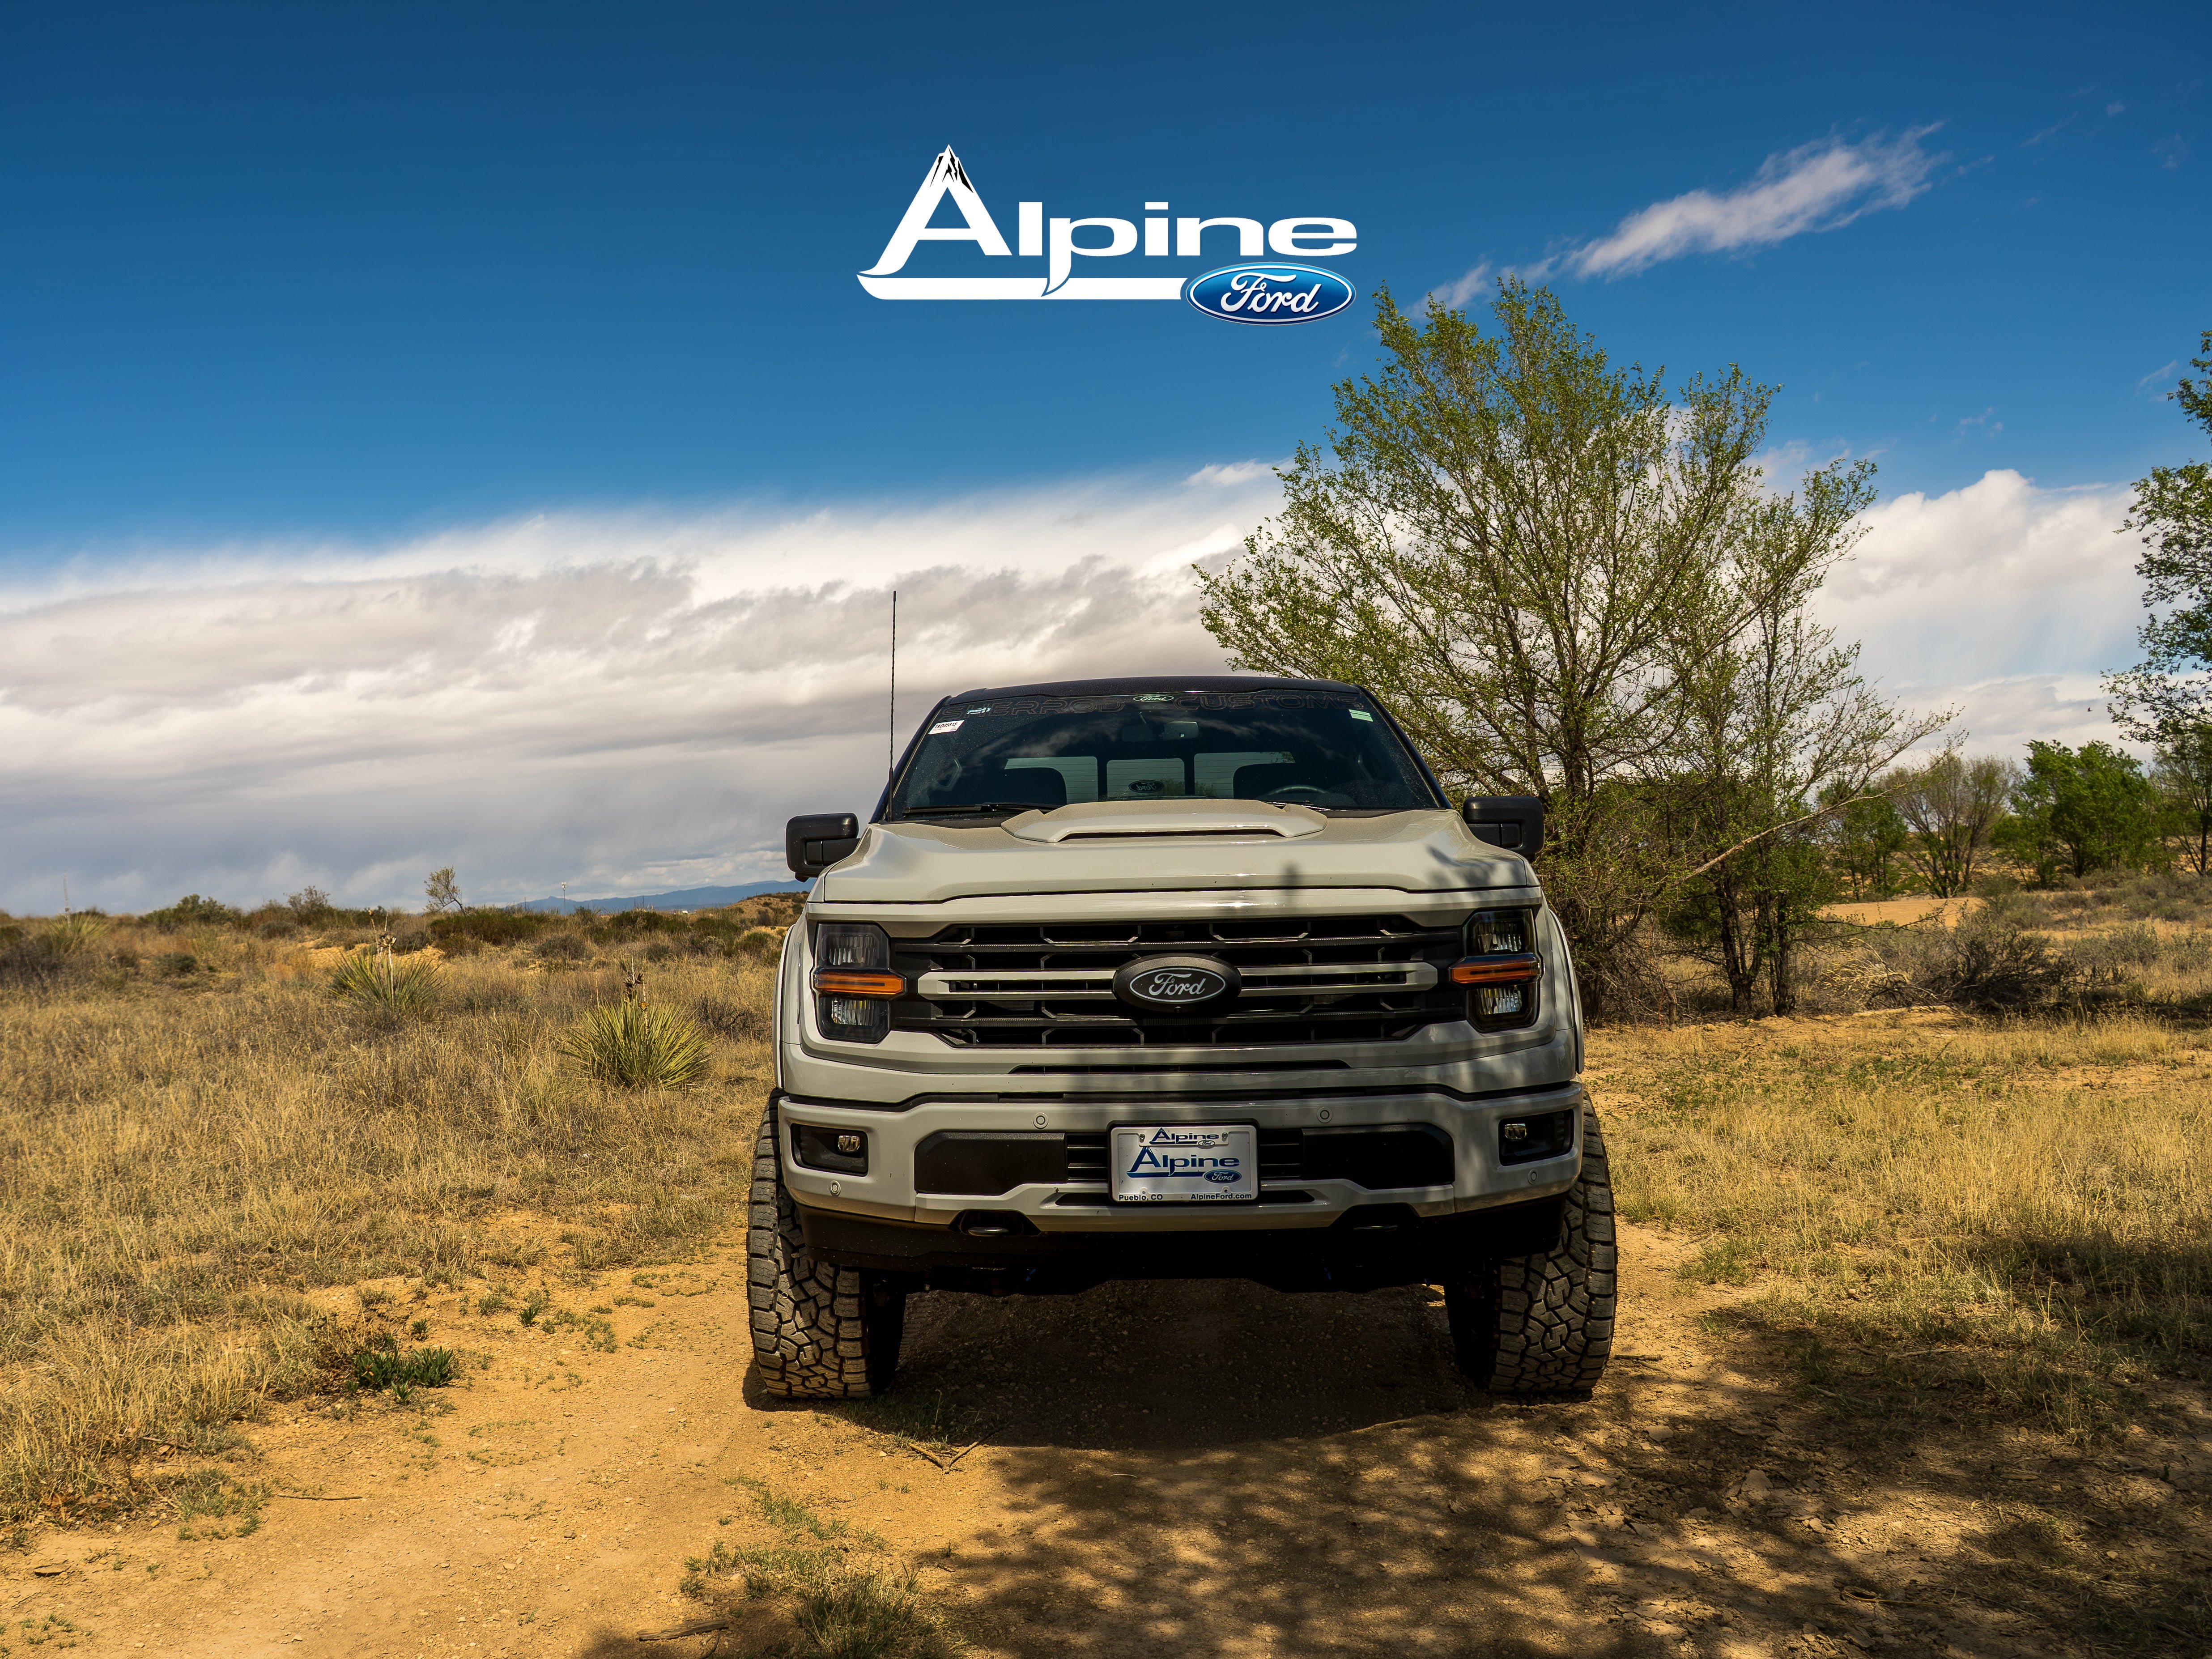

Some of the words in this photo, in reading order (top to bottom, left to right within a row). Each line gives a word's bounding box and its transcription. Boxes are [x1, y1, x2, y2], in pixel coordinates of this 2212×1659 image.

[938, 699, 1126, 721] SHERROD
[1173, 693, 1364, 711] CUSTOMS
[1149, 973, 1206, 995] Ford
[1149, 1127, 1220, 1144] Alpine
[1126, 1146, 1240, 1176] Alpine
[1212, 1171, 1234, 1181] Ford
